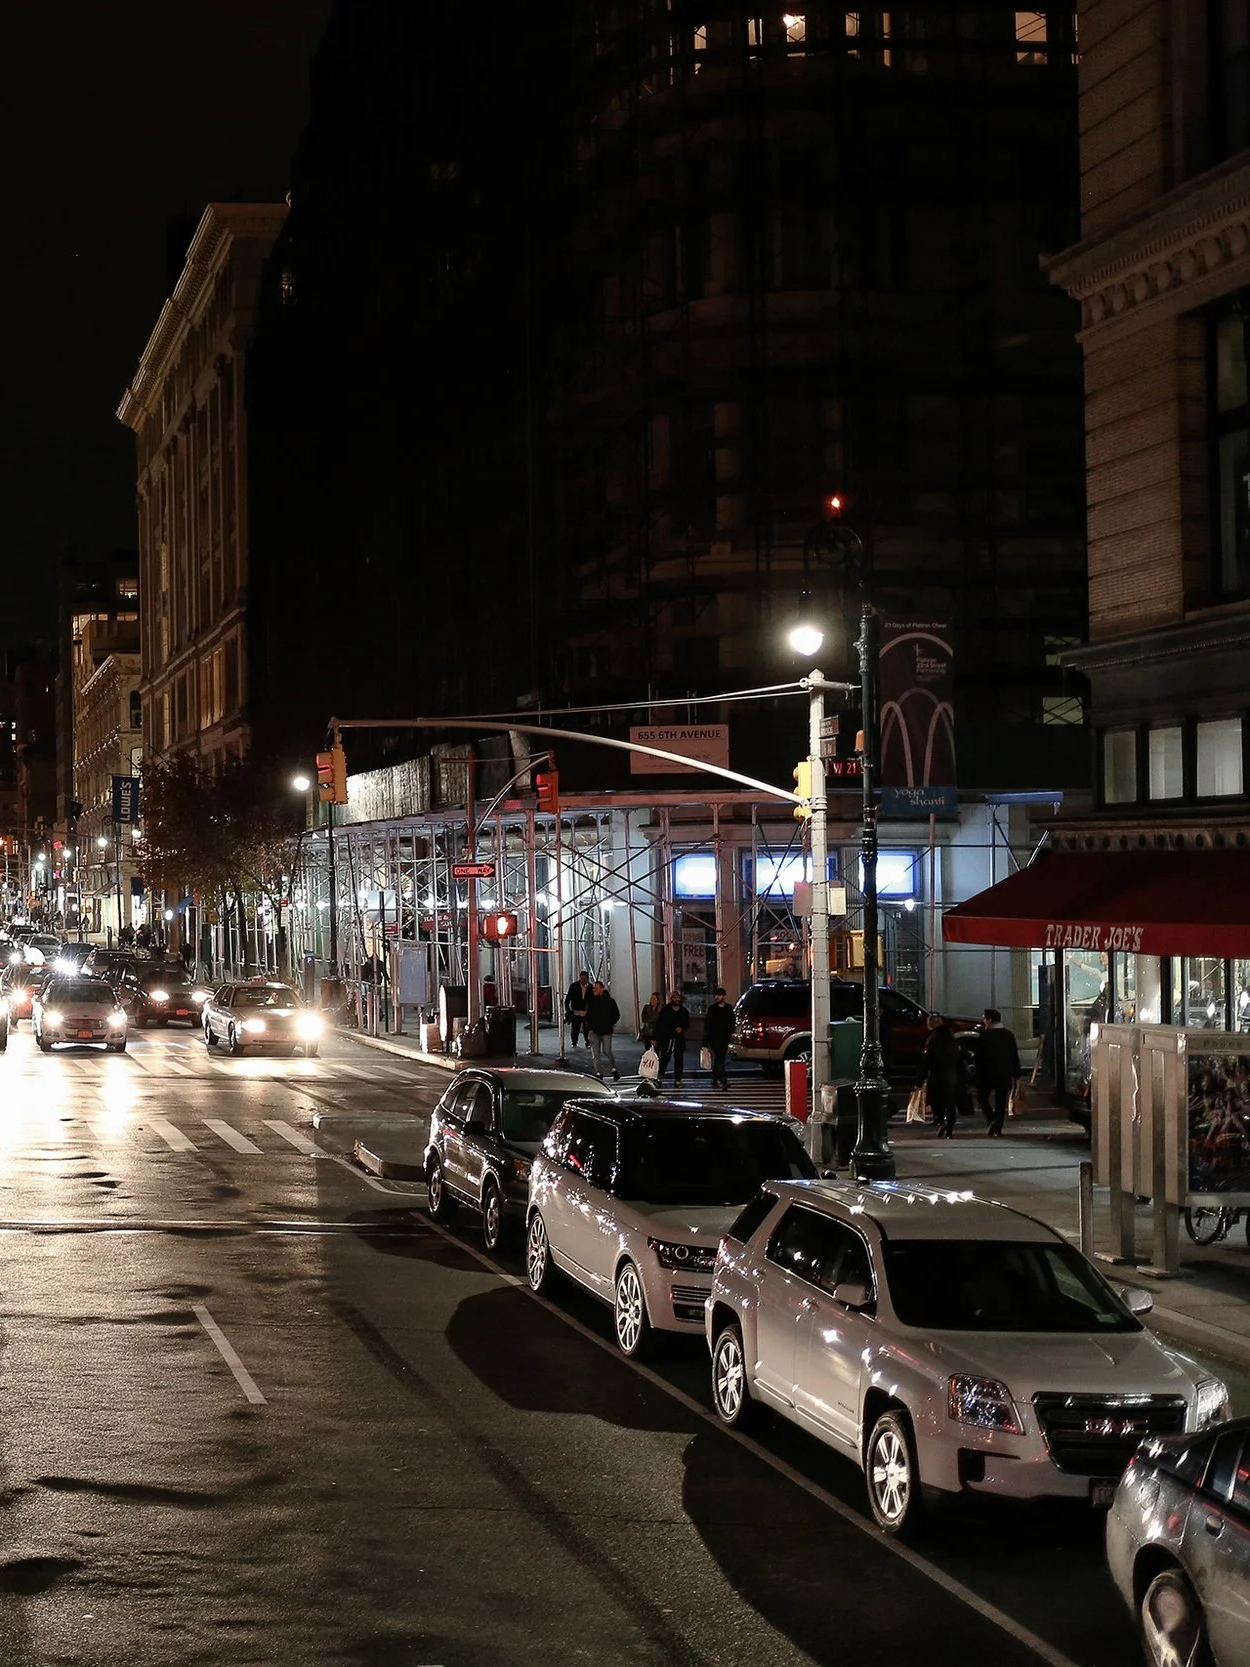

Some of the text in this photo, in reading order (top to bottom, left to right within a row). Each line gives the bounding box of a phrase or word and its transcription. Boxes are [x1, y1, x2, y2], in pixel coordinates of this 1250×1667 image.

[638, 730, 721, 740] 655 6TH AVENUE
[833, 762, 857, 774] W 21
[894, 788, 925, 798] yoga
[910, 796, 945, 806] shanti
[1045, 924, 1144, 952] TRADER JOE'S
[683, 943, 704, 957] FREE
